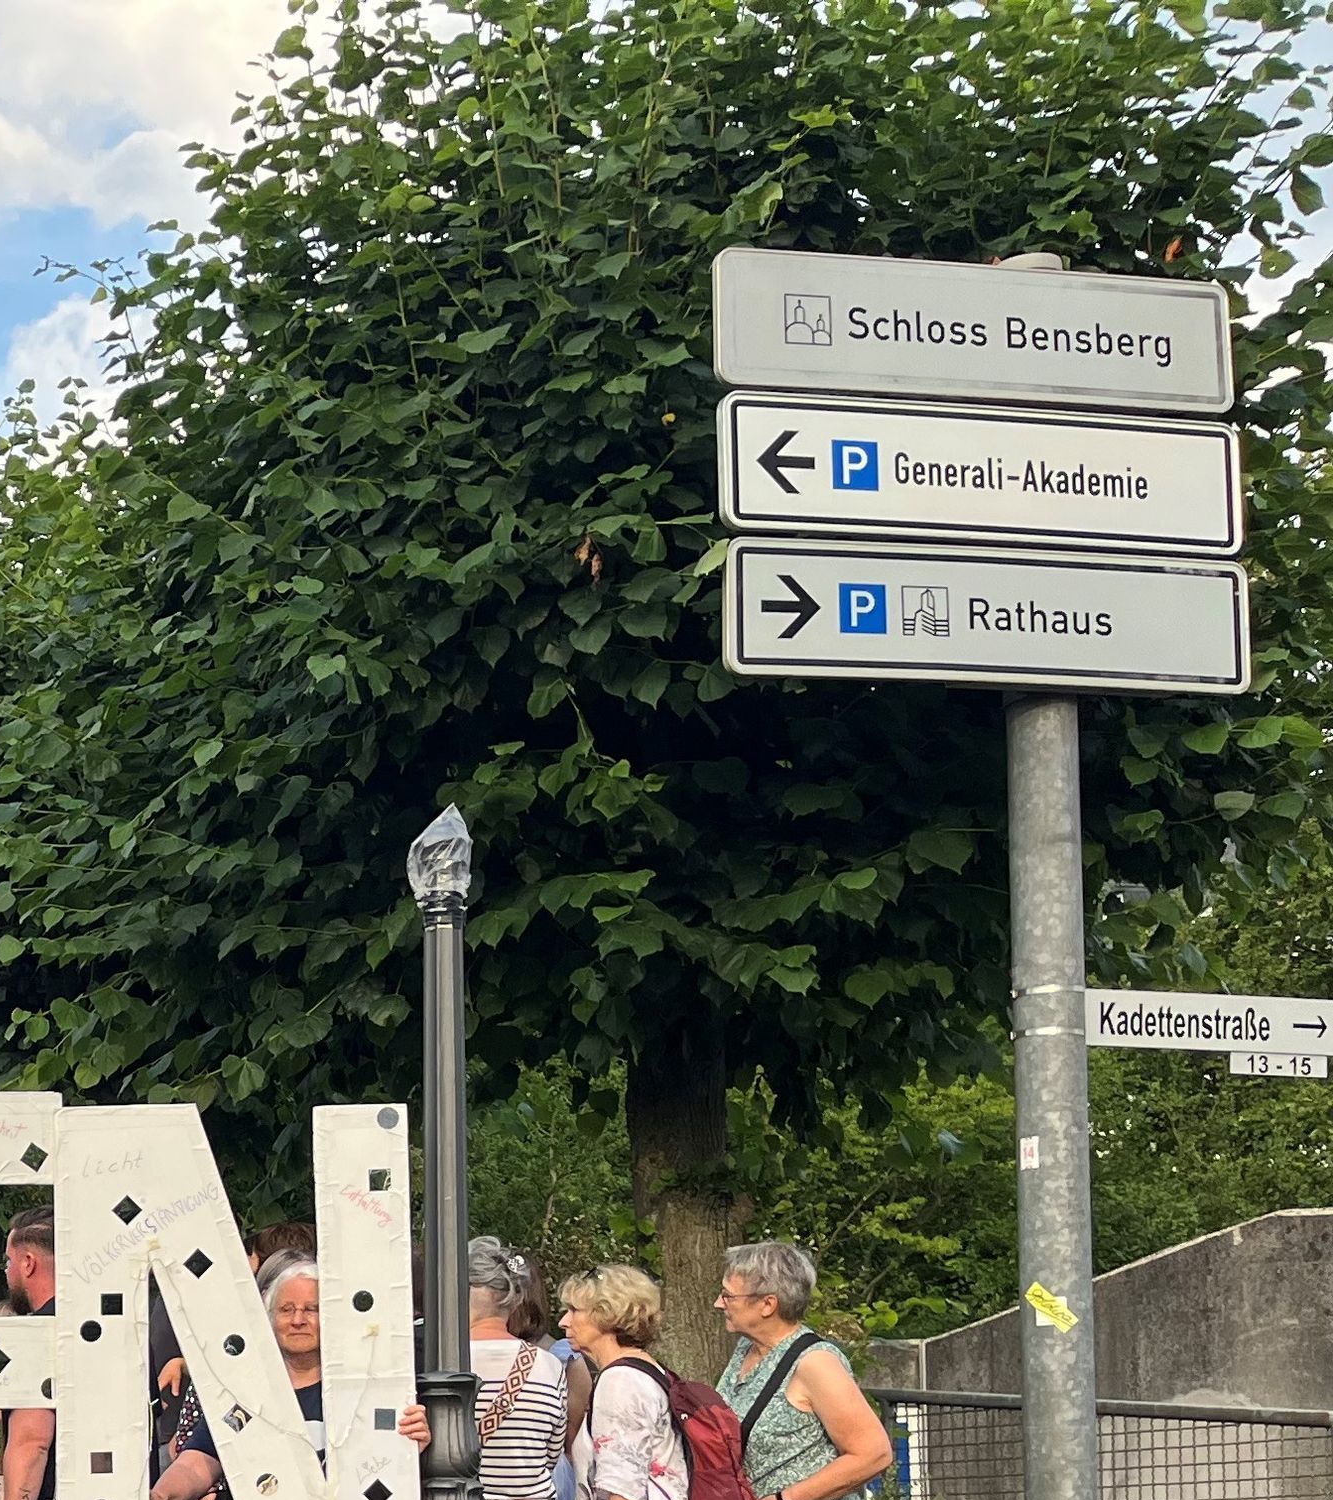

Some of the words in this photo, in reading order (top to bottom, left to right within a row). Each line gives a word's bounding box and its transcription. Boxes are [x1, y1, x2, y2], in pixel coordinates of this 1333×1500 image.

[847, 306, 988, 347] Schloss
[1005, 316, 1173, 367] Bensberg
[840, 445, 869, 485] P
[893, 451, 1150, 501] Generali-Akademie
[849, 589, 876, 627] P
[968, 598, 1114, 637] Rathaus
[1099, 1001, 1271, 1042] Kadettenstraße
[1247, 1054, 1270, 1074] 13
[1289, 1056, 1313, 1076] 15
